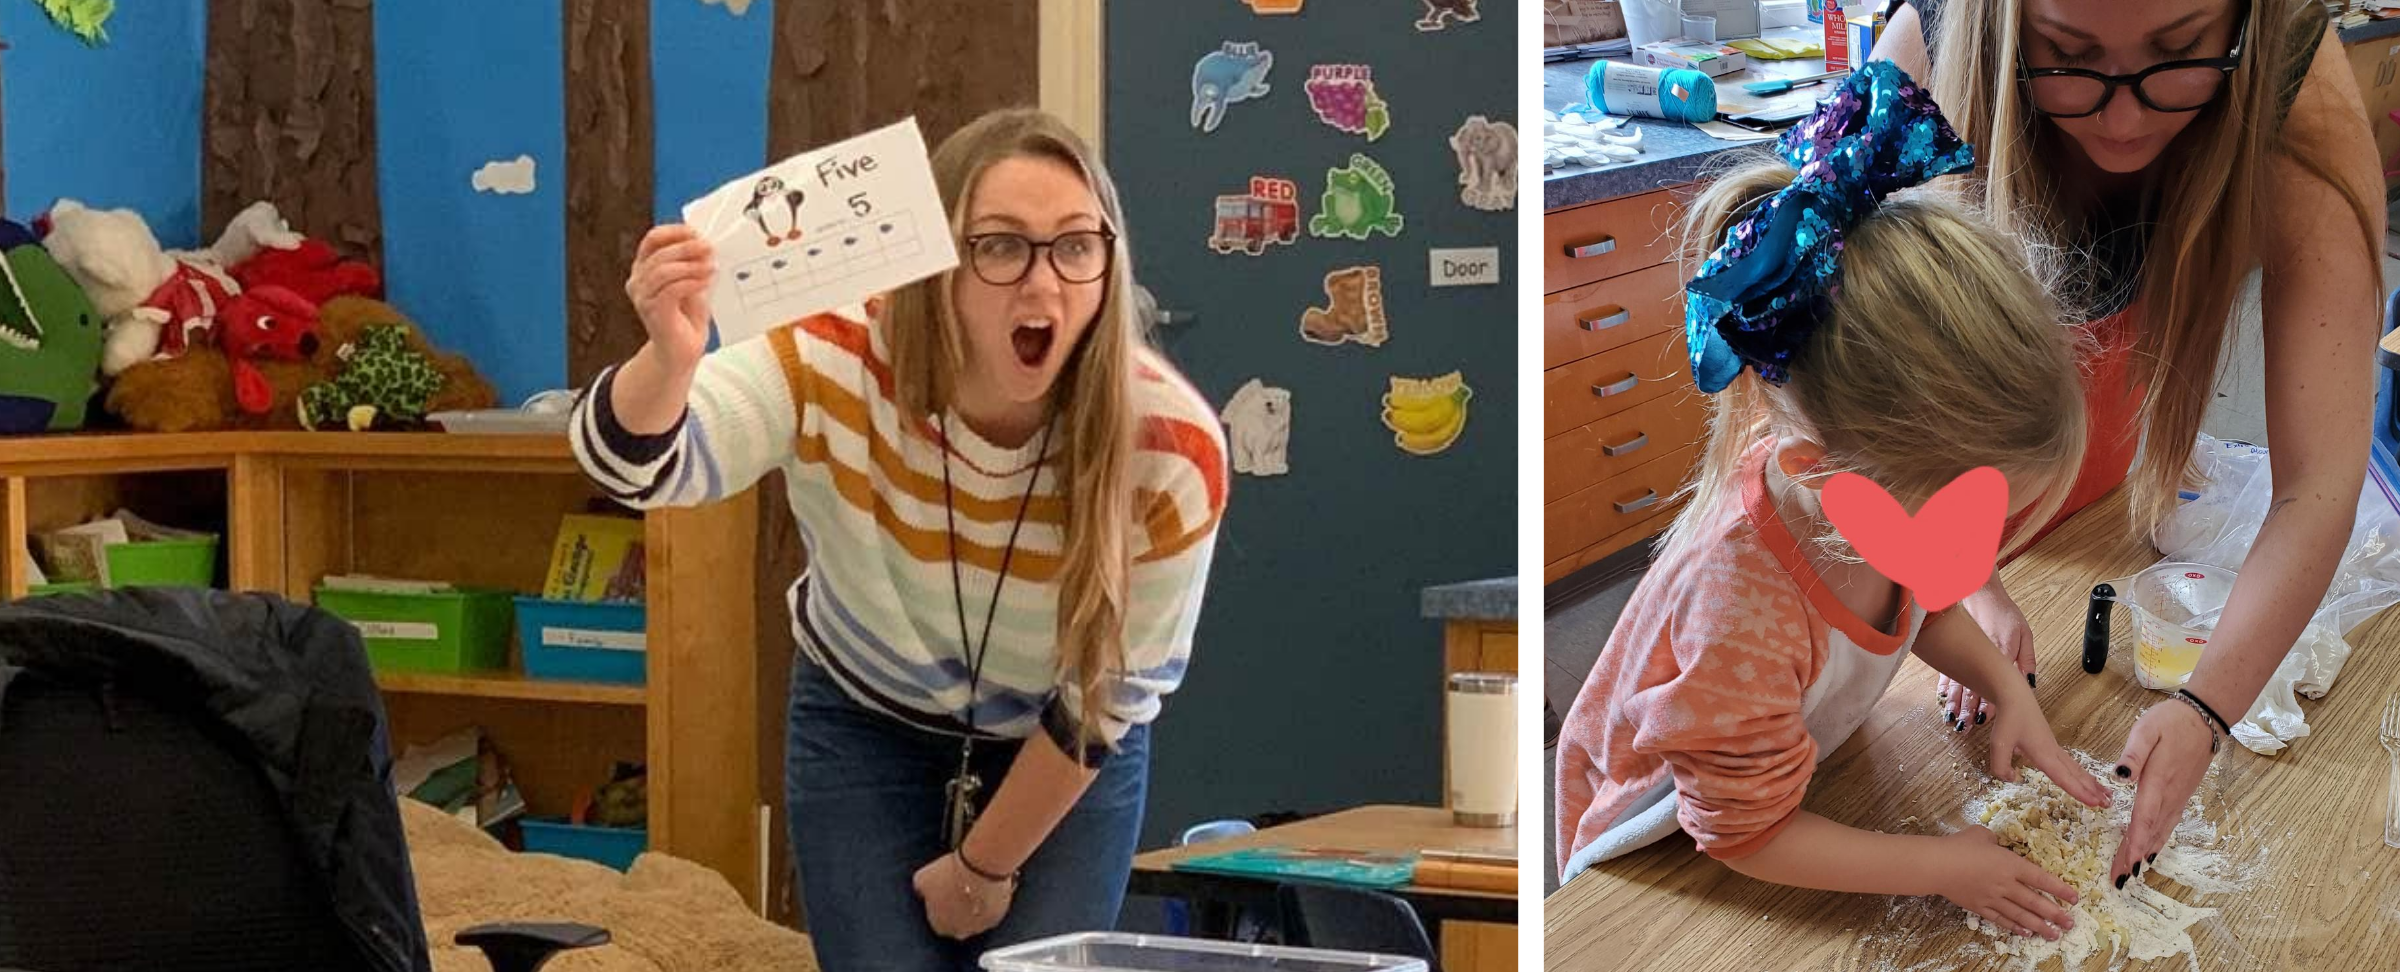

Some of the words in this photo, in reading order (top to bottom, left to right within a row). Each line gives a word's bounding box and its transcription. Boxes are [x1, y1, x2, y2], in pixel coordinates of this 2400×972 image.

[1827, 14, 1846, 22] WHO
[1832, 22, 1846, 30] MIL
[1313, 67, 1367, 80] PURPLE
[815, 154, 878, 188] Five
[1253, 179, 1294, 199] RED
[846, 191, 872, 217] 5
[1443, 260, 1488, 278] Door
[1367, 269, 1384, 339] BROWN
